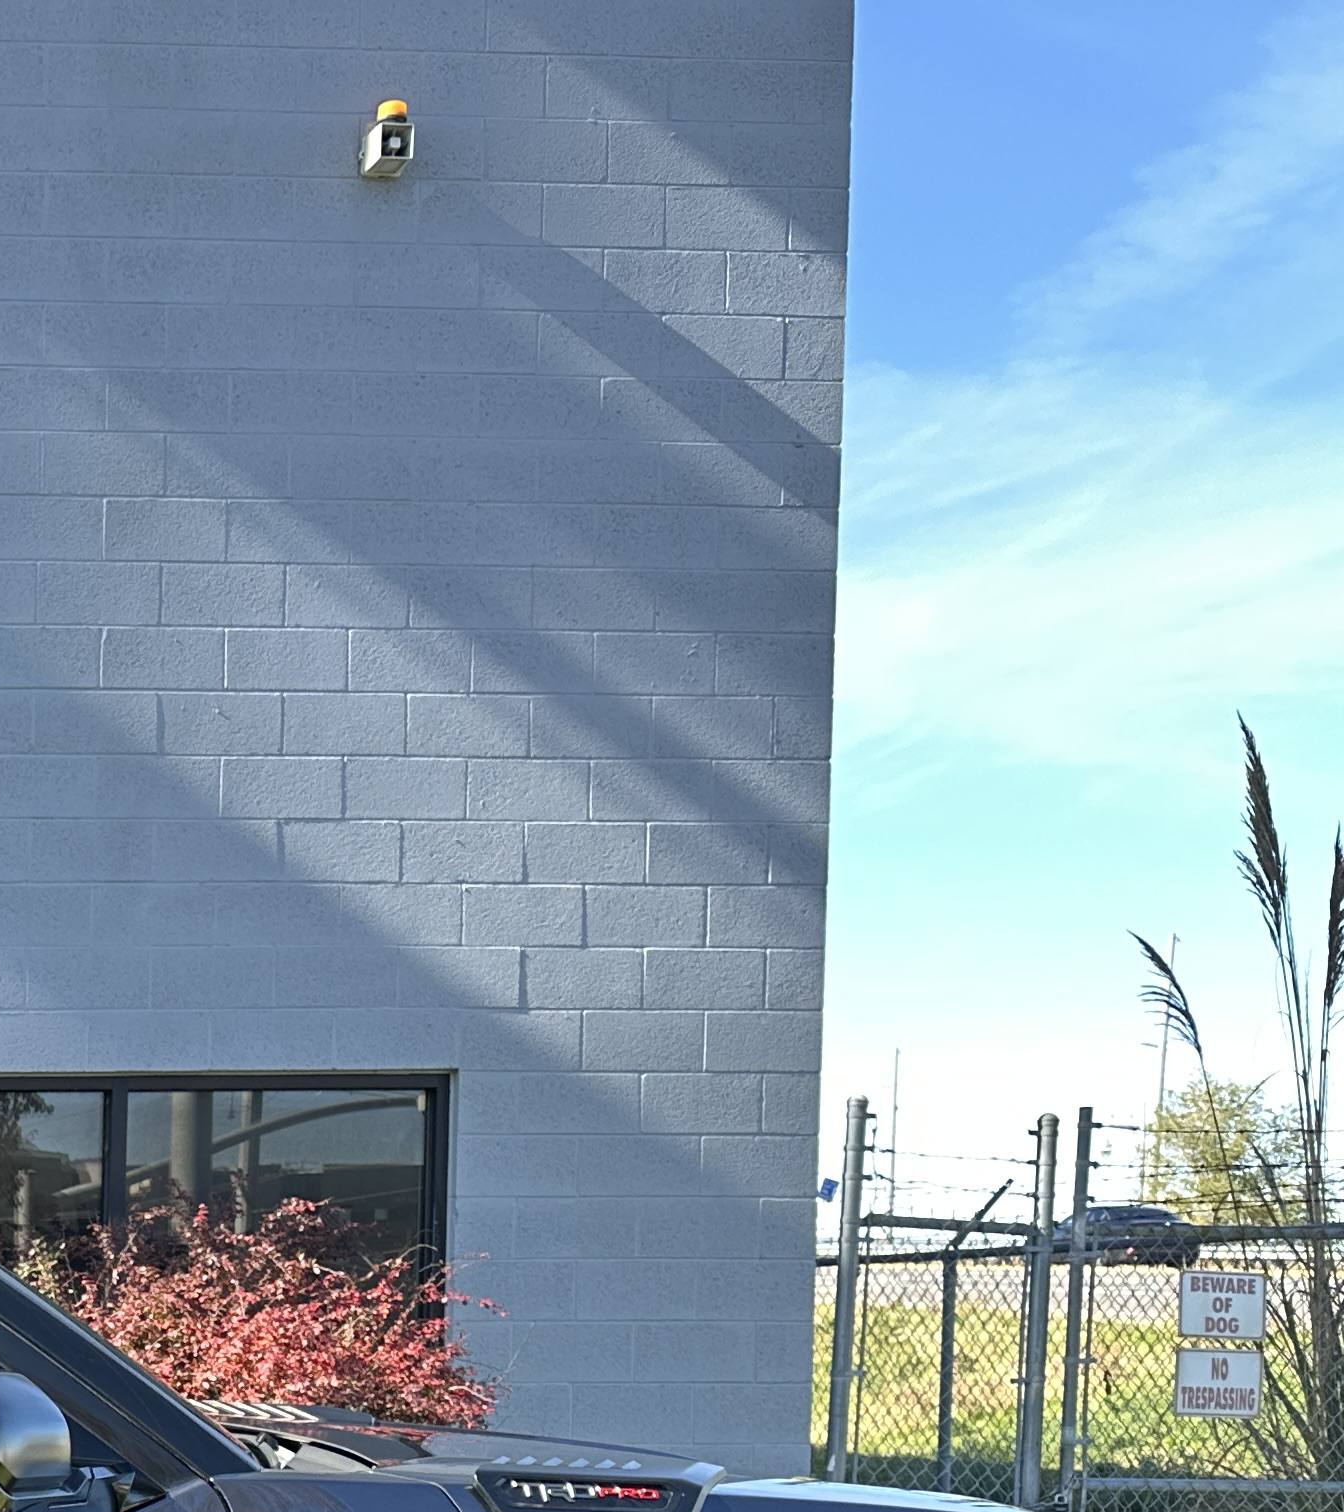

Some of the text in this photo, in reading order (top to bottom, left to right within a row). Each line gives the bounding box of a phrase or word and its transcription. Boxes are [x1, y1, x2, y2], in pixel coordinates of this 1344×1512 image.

[1190, 1276, 1256, 1295] BEWARE
[1212, 1297, 1233, 1313] OF
[1204, 1317, 1240, 1334] DOG
[1211, 1357, 1229, 1381] NO
[1181, 1386, 1256, 1411] TRESPASSING
[511, 1480, 661, 1503] TRD PRO
